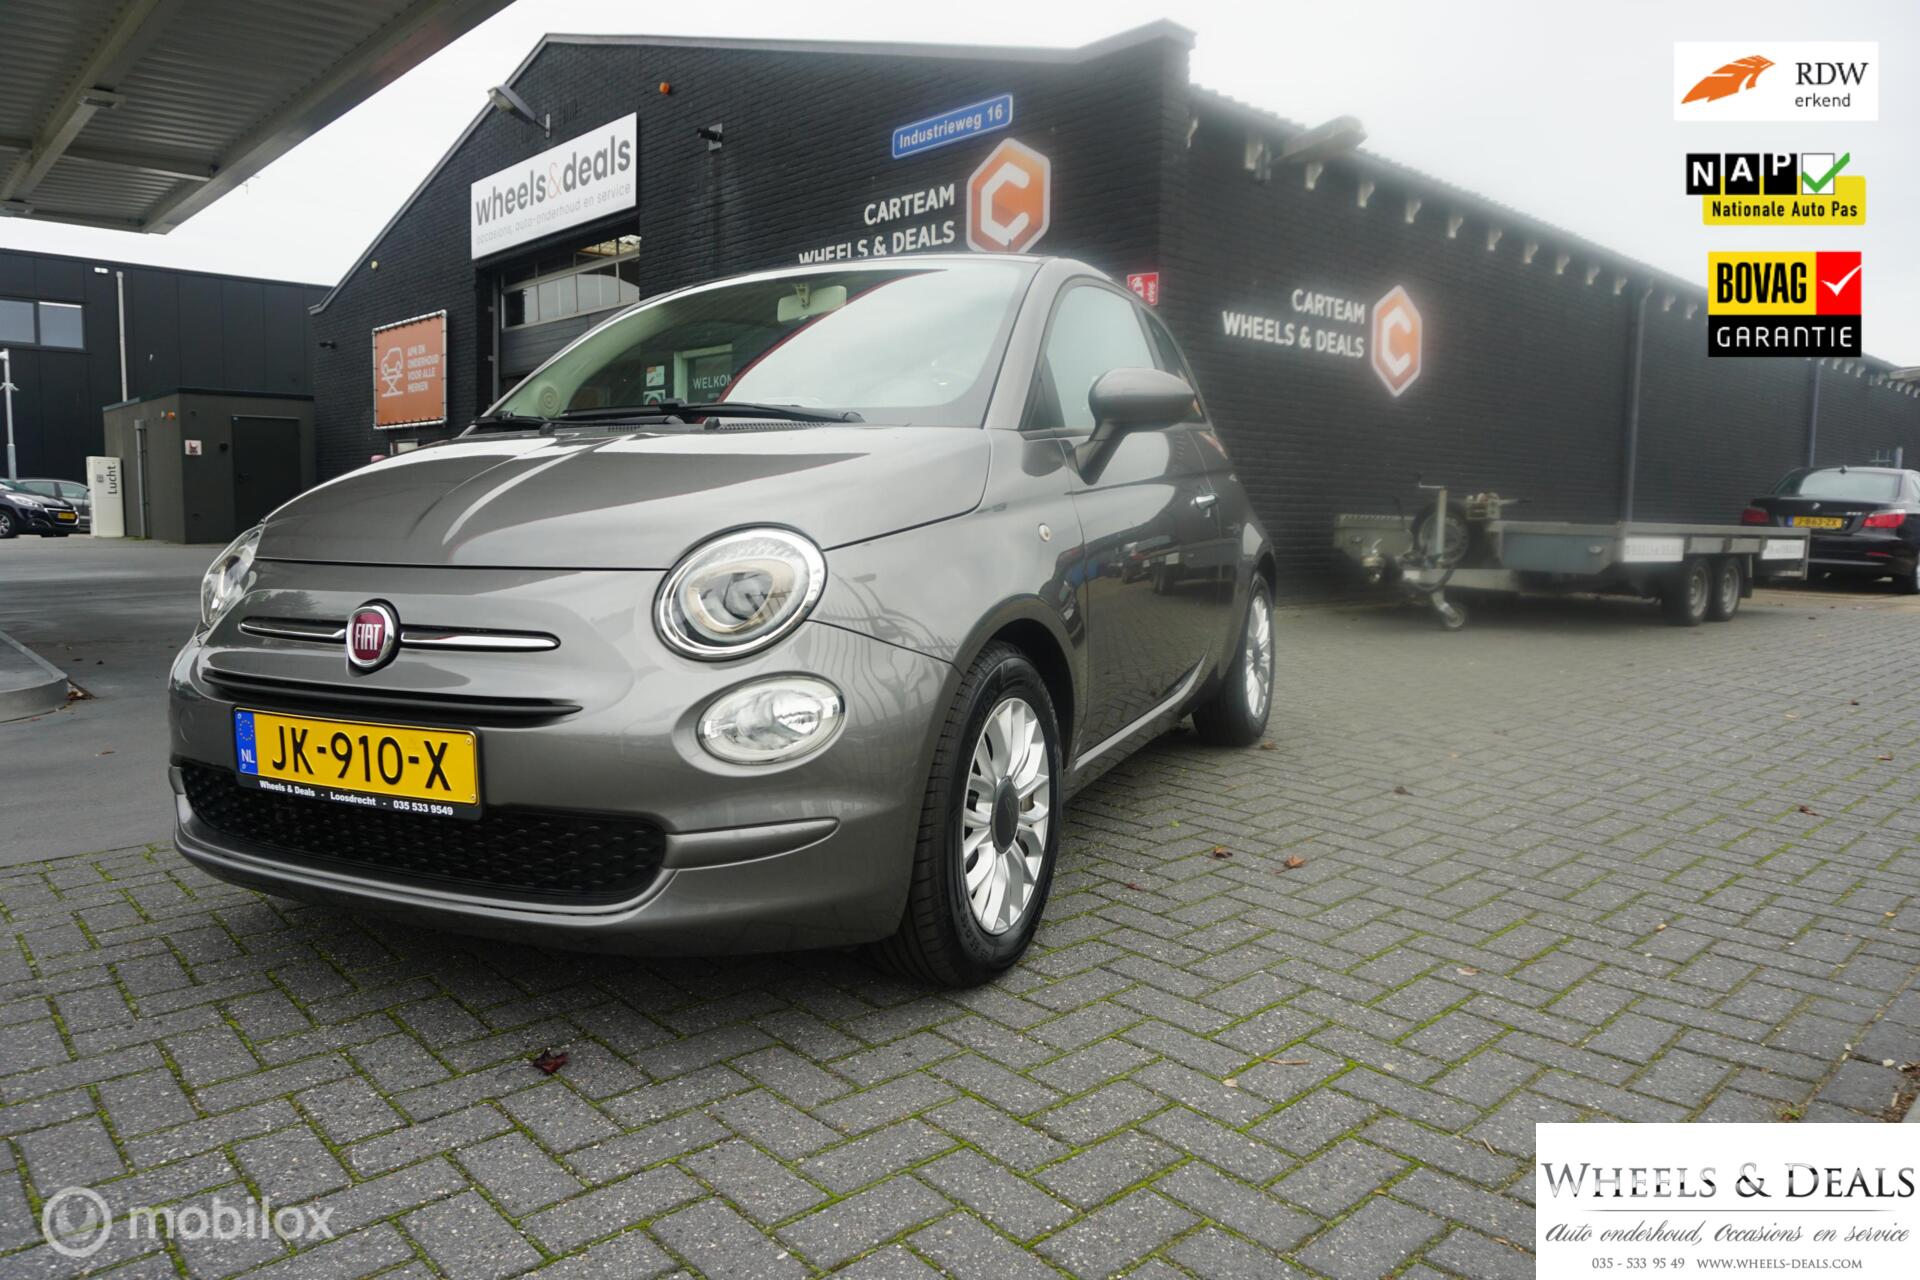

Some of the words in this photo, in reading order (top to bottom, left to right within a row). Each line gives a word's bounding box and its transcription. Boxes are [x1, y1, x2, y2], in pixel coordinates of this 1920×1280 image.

[899, 112, 982, 149] Industrieweg
[987, 103, 1003, 122] 16
[584, 196, 594, 208] en
[596, 182, 631, 205] service
[864, 184, 955, 226] CARTEAM
[873, 235, 887, 256] &
[892, 220, 956, 254] DEALS
[1291, 288, 1366, 325] CARTEAM
[1222, 310, 1295, 347] WHEELS
[1299, 325, 1312, 349] &
[1315, 329, 1365, 359] DEALS
[106, 465, 117, 495] Lucht
[355, 623, 382, 650] FIAT
[241, 748, 255, 764] NL
[271, 725, 452, 792] JK-910-X
[259, 780, 286, 793] Wheels
[287, 784, 293, 794] &
[294, 785, 315, 798] Deals
[330, 791, 376, 806] Loosdrecht
[393, 799, 410, 811] 035
[412, 802, 429, 813] 533
[430, 804, 454, 816] 9549
